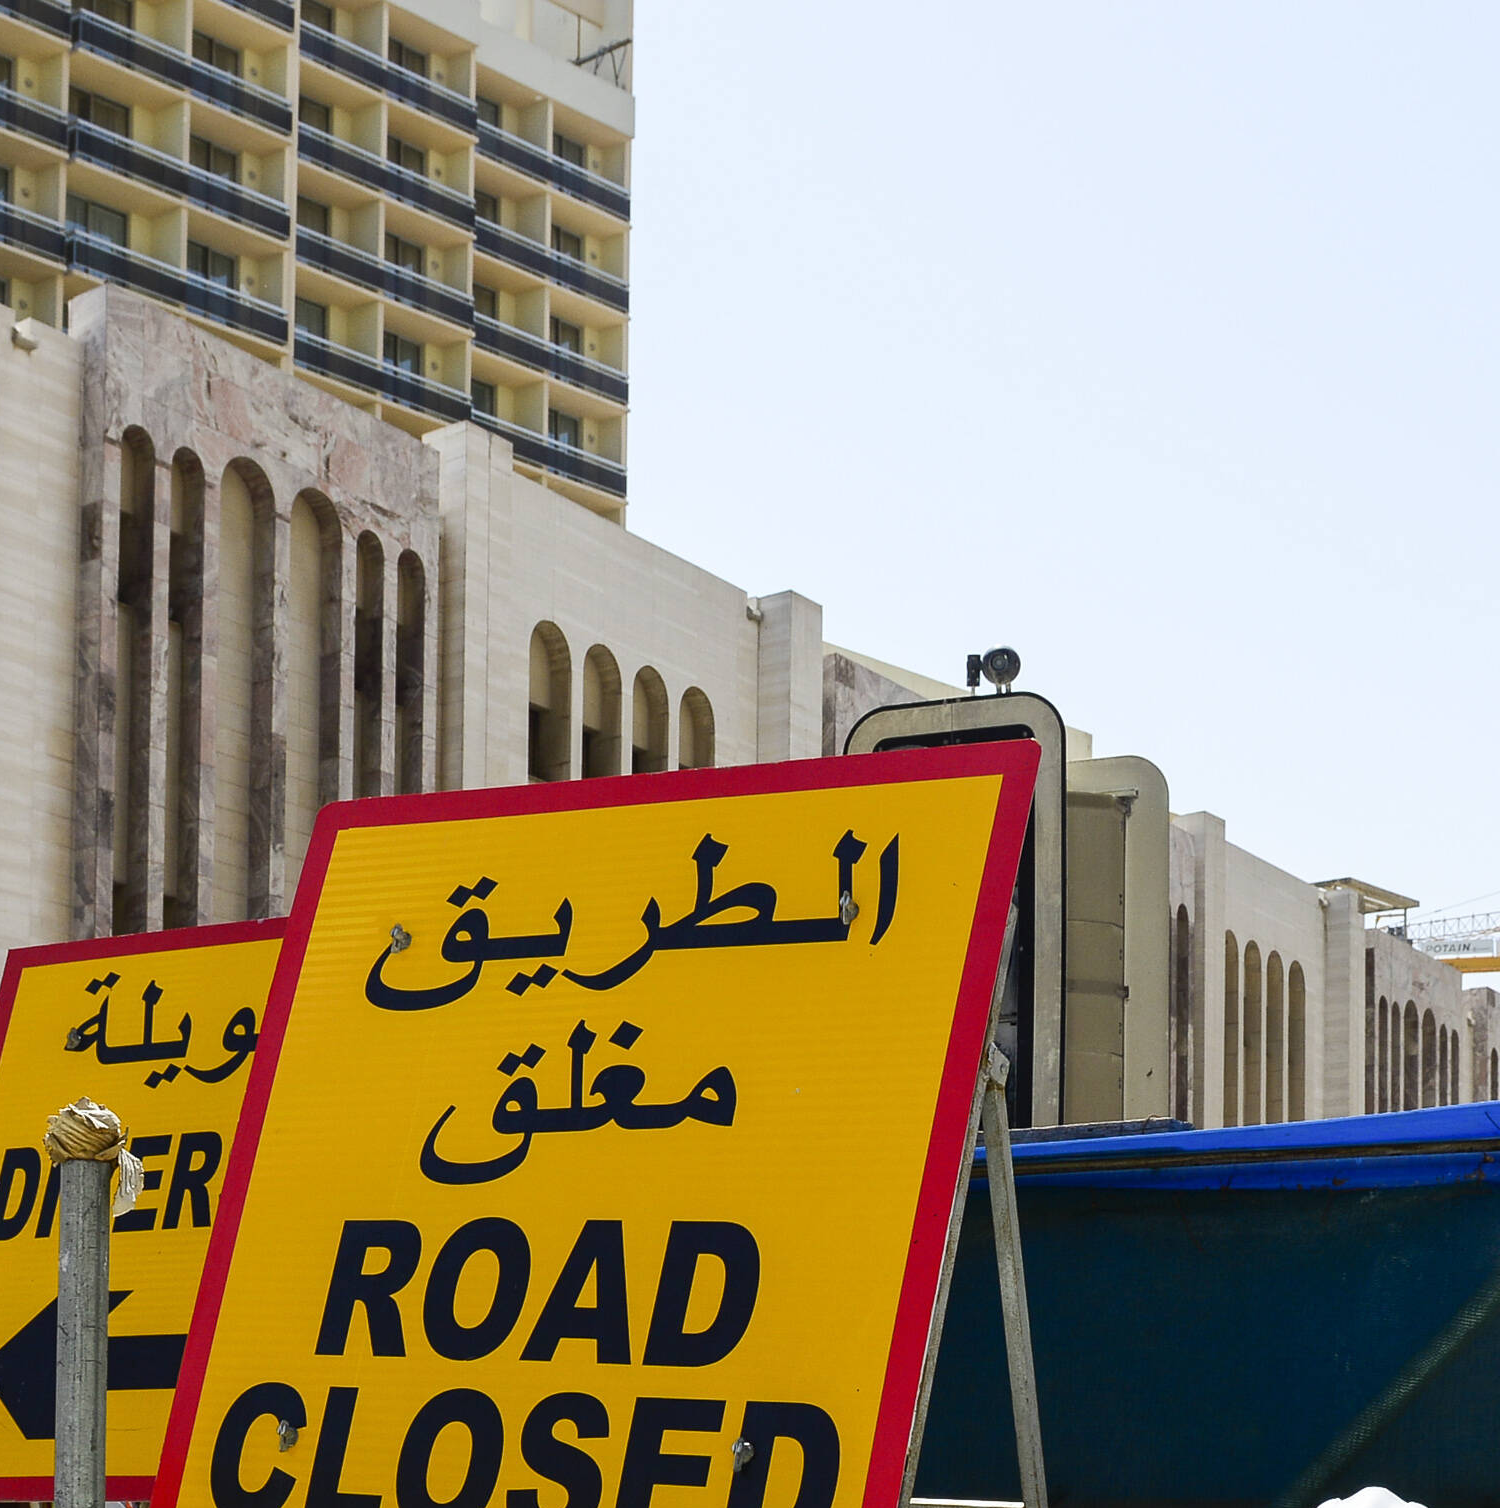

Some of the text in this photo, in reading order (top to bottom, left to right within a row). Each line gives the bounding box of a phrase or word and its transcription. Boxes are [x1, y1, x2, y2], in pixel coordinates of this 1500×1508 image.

[366, 830, 898, 1010] الطريق
[64, 972, 260, 1088] ويلة
[420, 1020, 737, 1185] مغلق
[315, 1217, 760, 1368] ROAD
